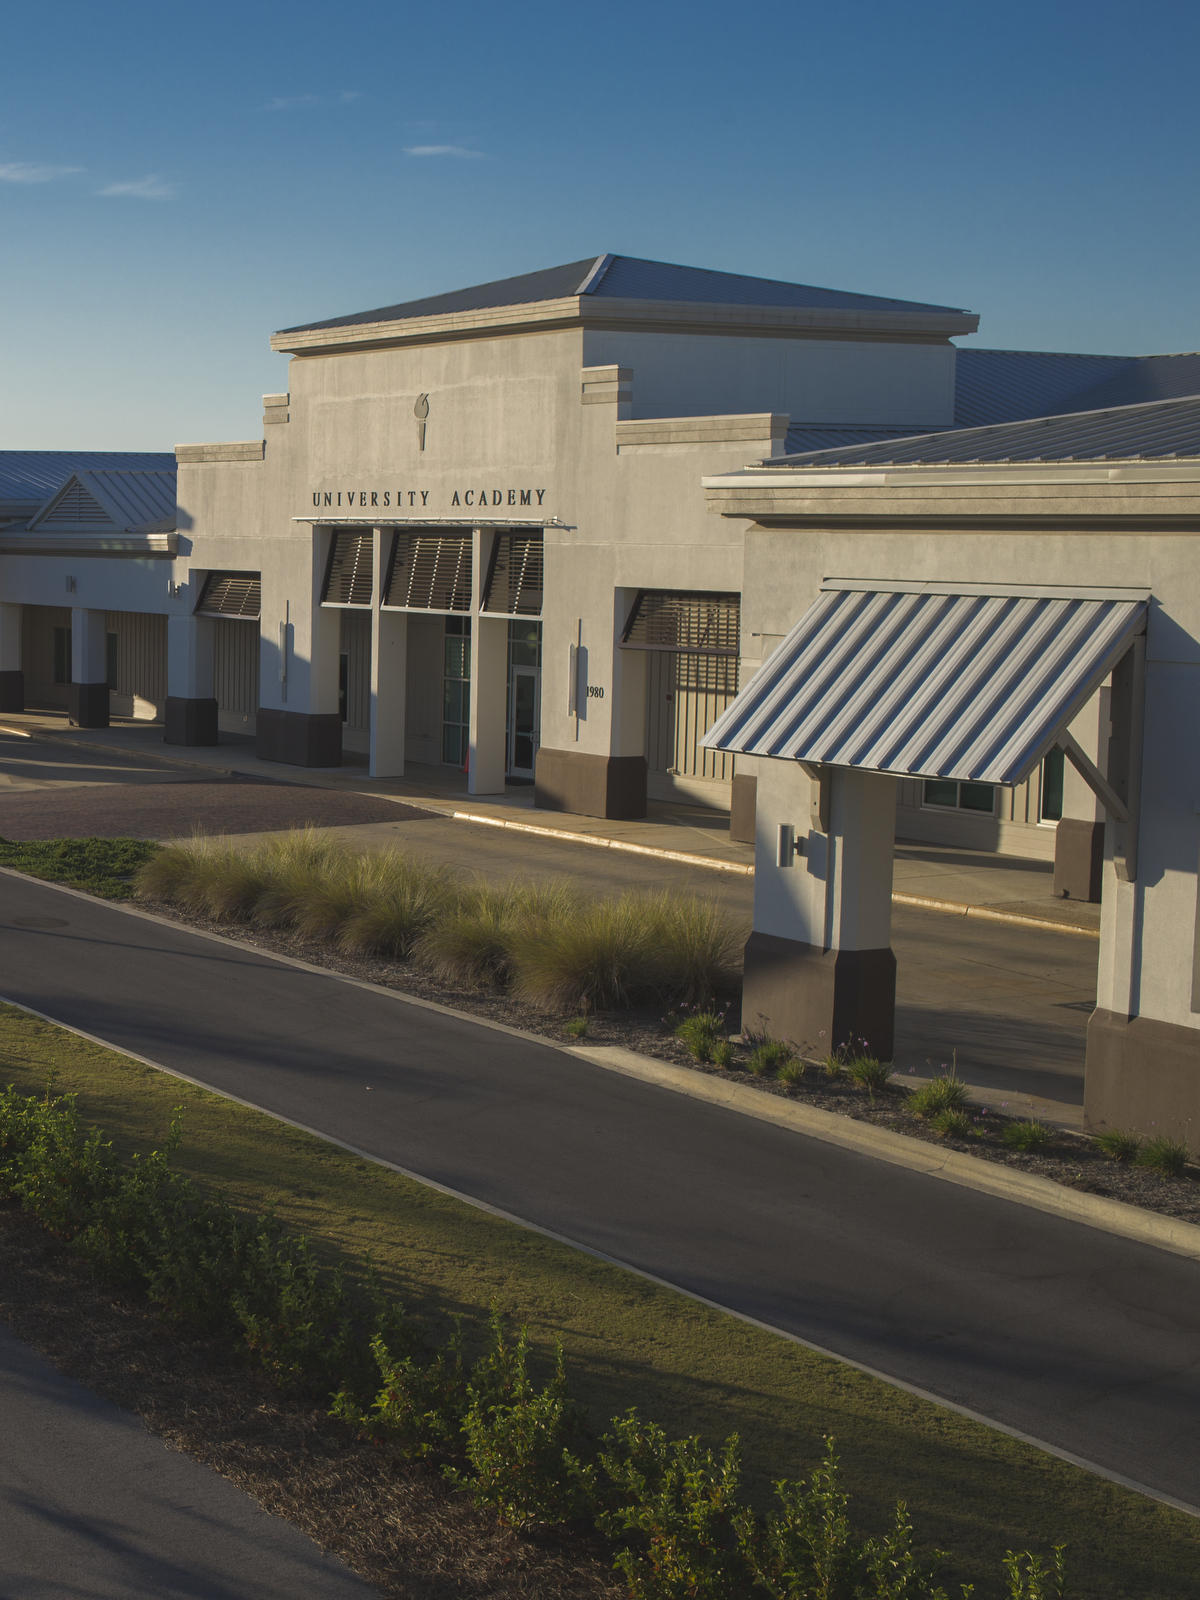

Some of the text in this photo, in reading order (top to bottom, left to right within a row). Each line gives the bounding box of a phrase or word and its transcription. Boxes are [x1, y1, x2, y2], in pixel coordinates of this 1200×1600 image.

[313, 489, 546, 506] UNIVERSITY ACADEMY
[586, 686, 604, 698] 1980
